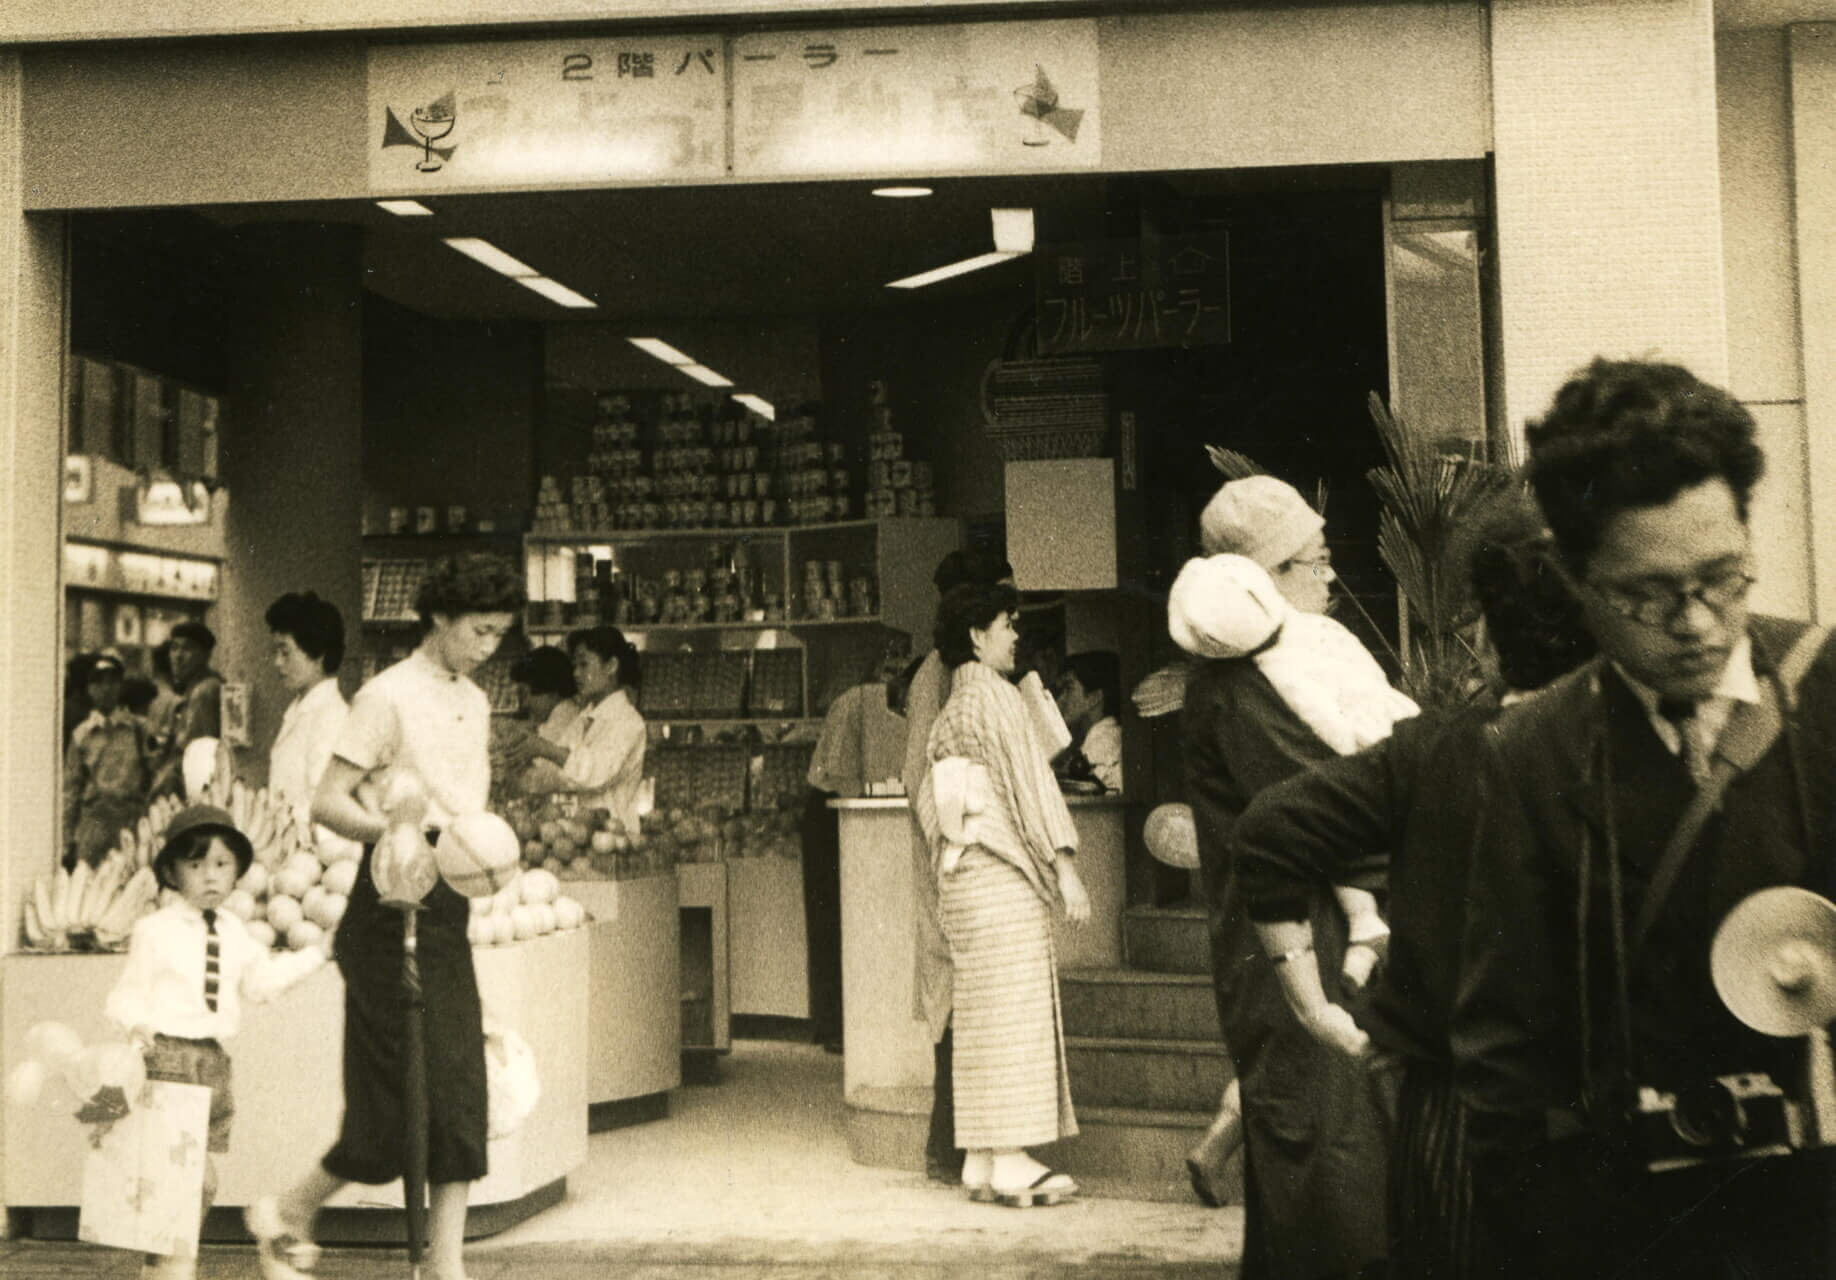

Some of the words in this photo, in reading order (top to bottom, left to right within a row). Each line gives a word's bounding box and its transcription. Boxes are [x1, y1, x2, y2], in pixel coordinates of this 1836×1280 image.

[1044, 288, 1221, 342] フルーツパーラー
